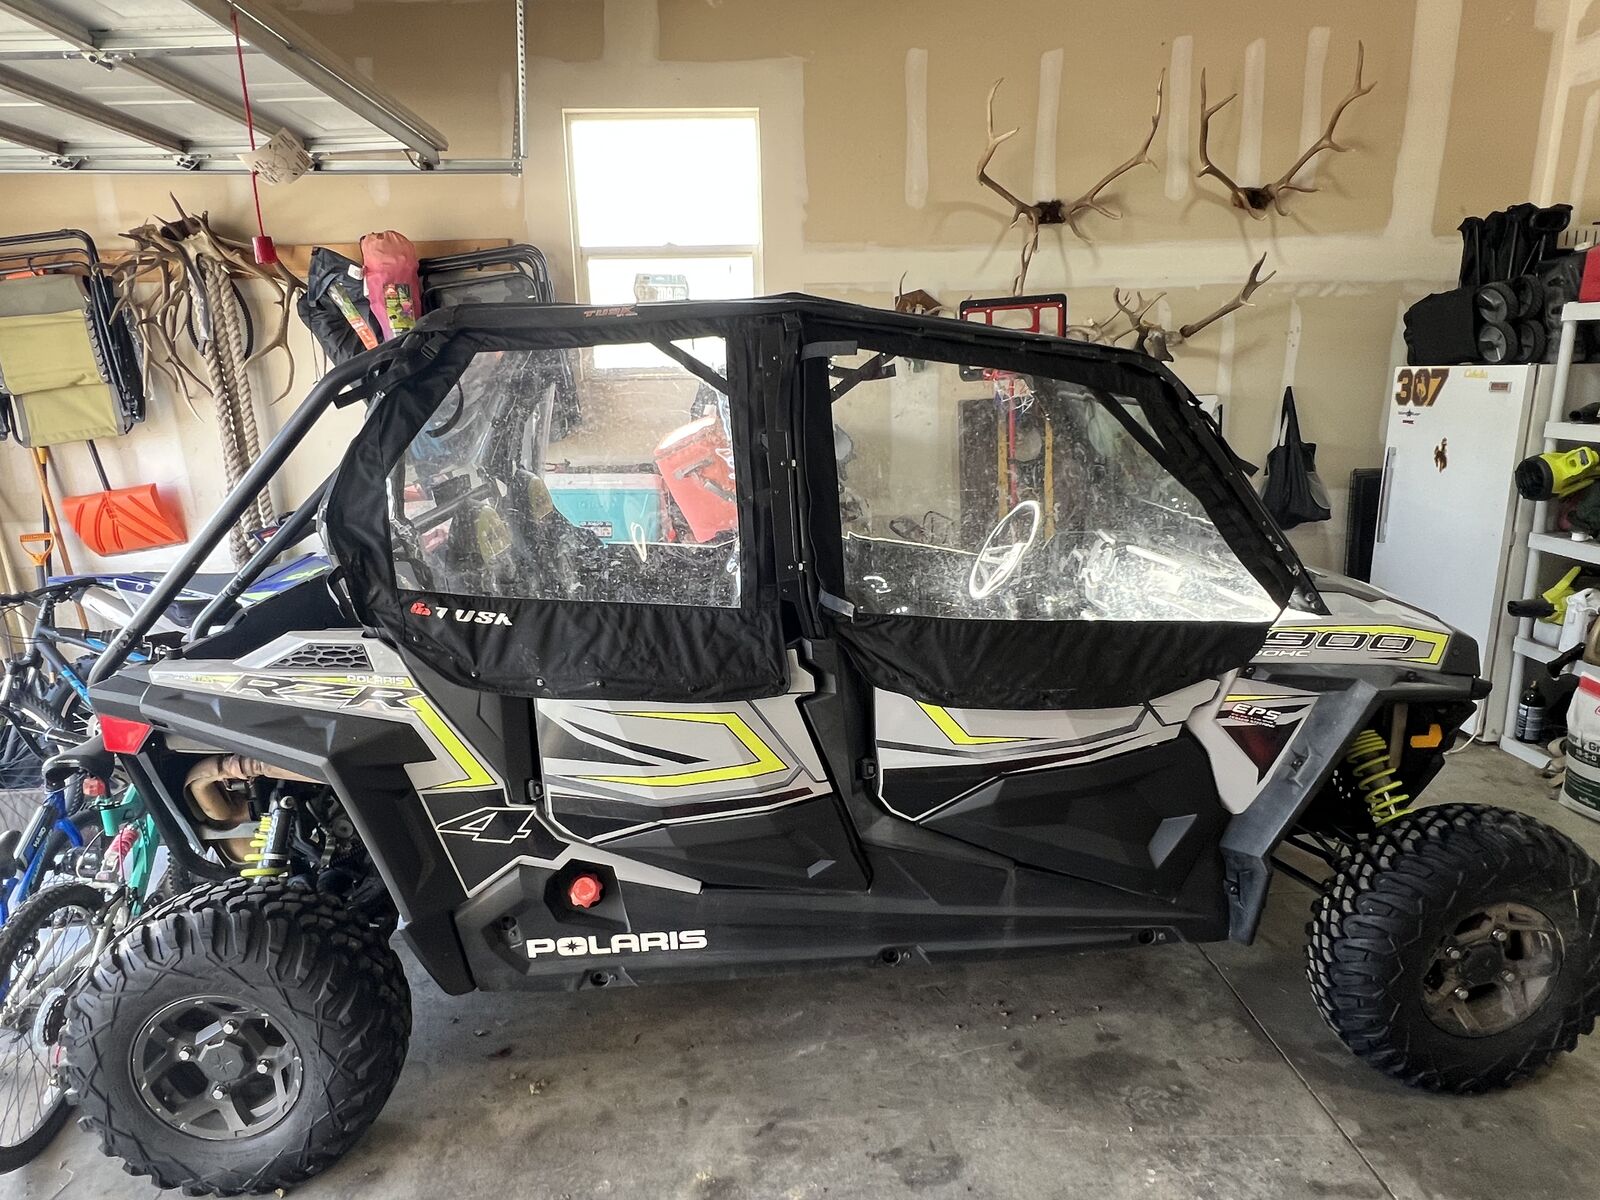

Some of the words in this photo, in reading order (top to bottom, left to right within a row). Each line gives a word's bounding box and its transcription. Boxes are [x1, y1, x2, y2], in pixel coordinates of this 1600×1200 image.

[1395, 368, 1450, 407] 307
[435, 606, 513, 626] TUSK
[1262, 630, 1416, 653] 900
[224, 673, 425, 711] RZR
[346, 674, 405, 685] POLARIS
[1231, 702, 1282, 721] EPS
[435, 806, 537, 844] 4
[526, 929, 708, 958] POLARIS
